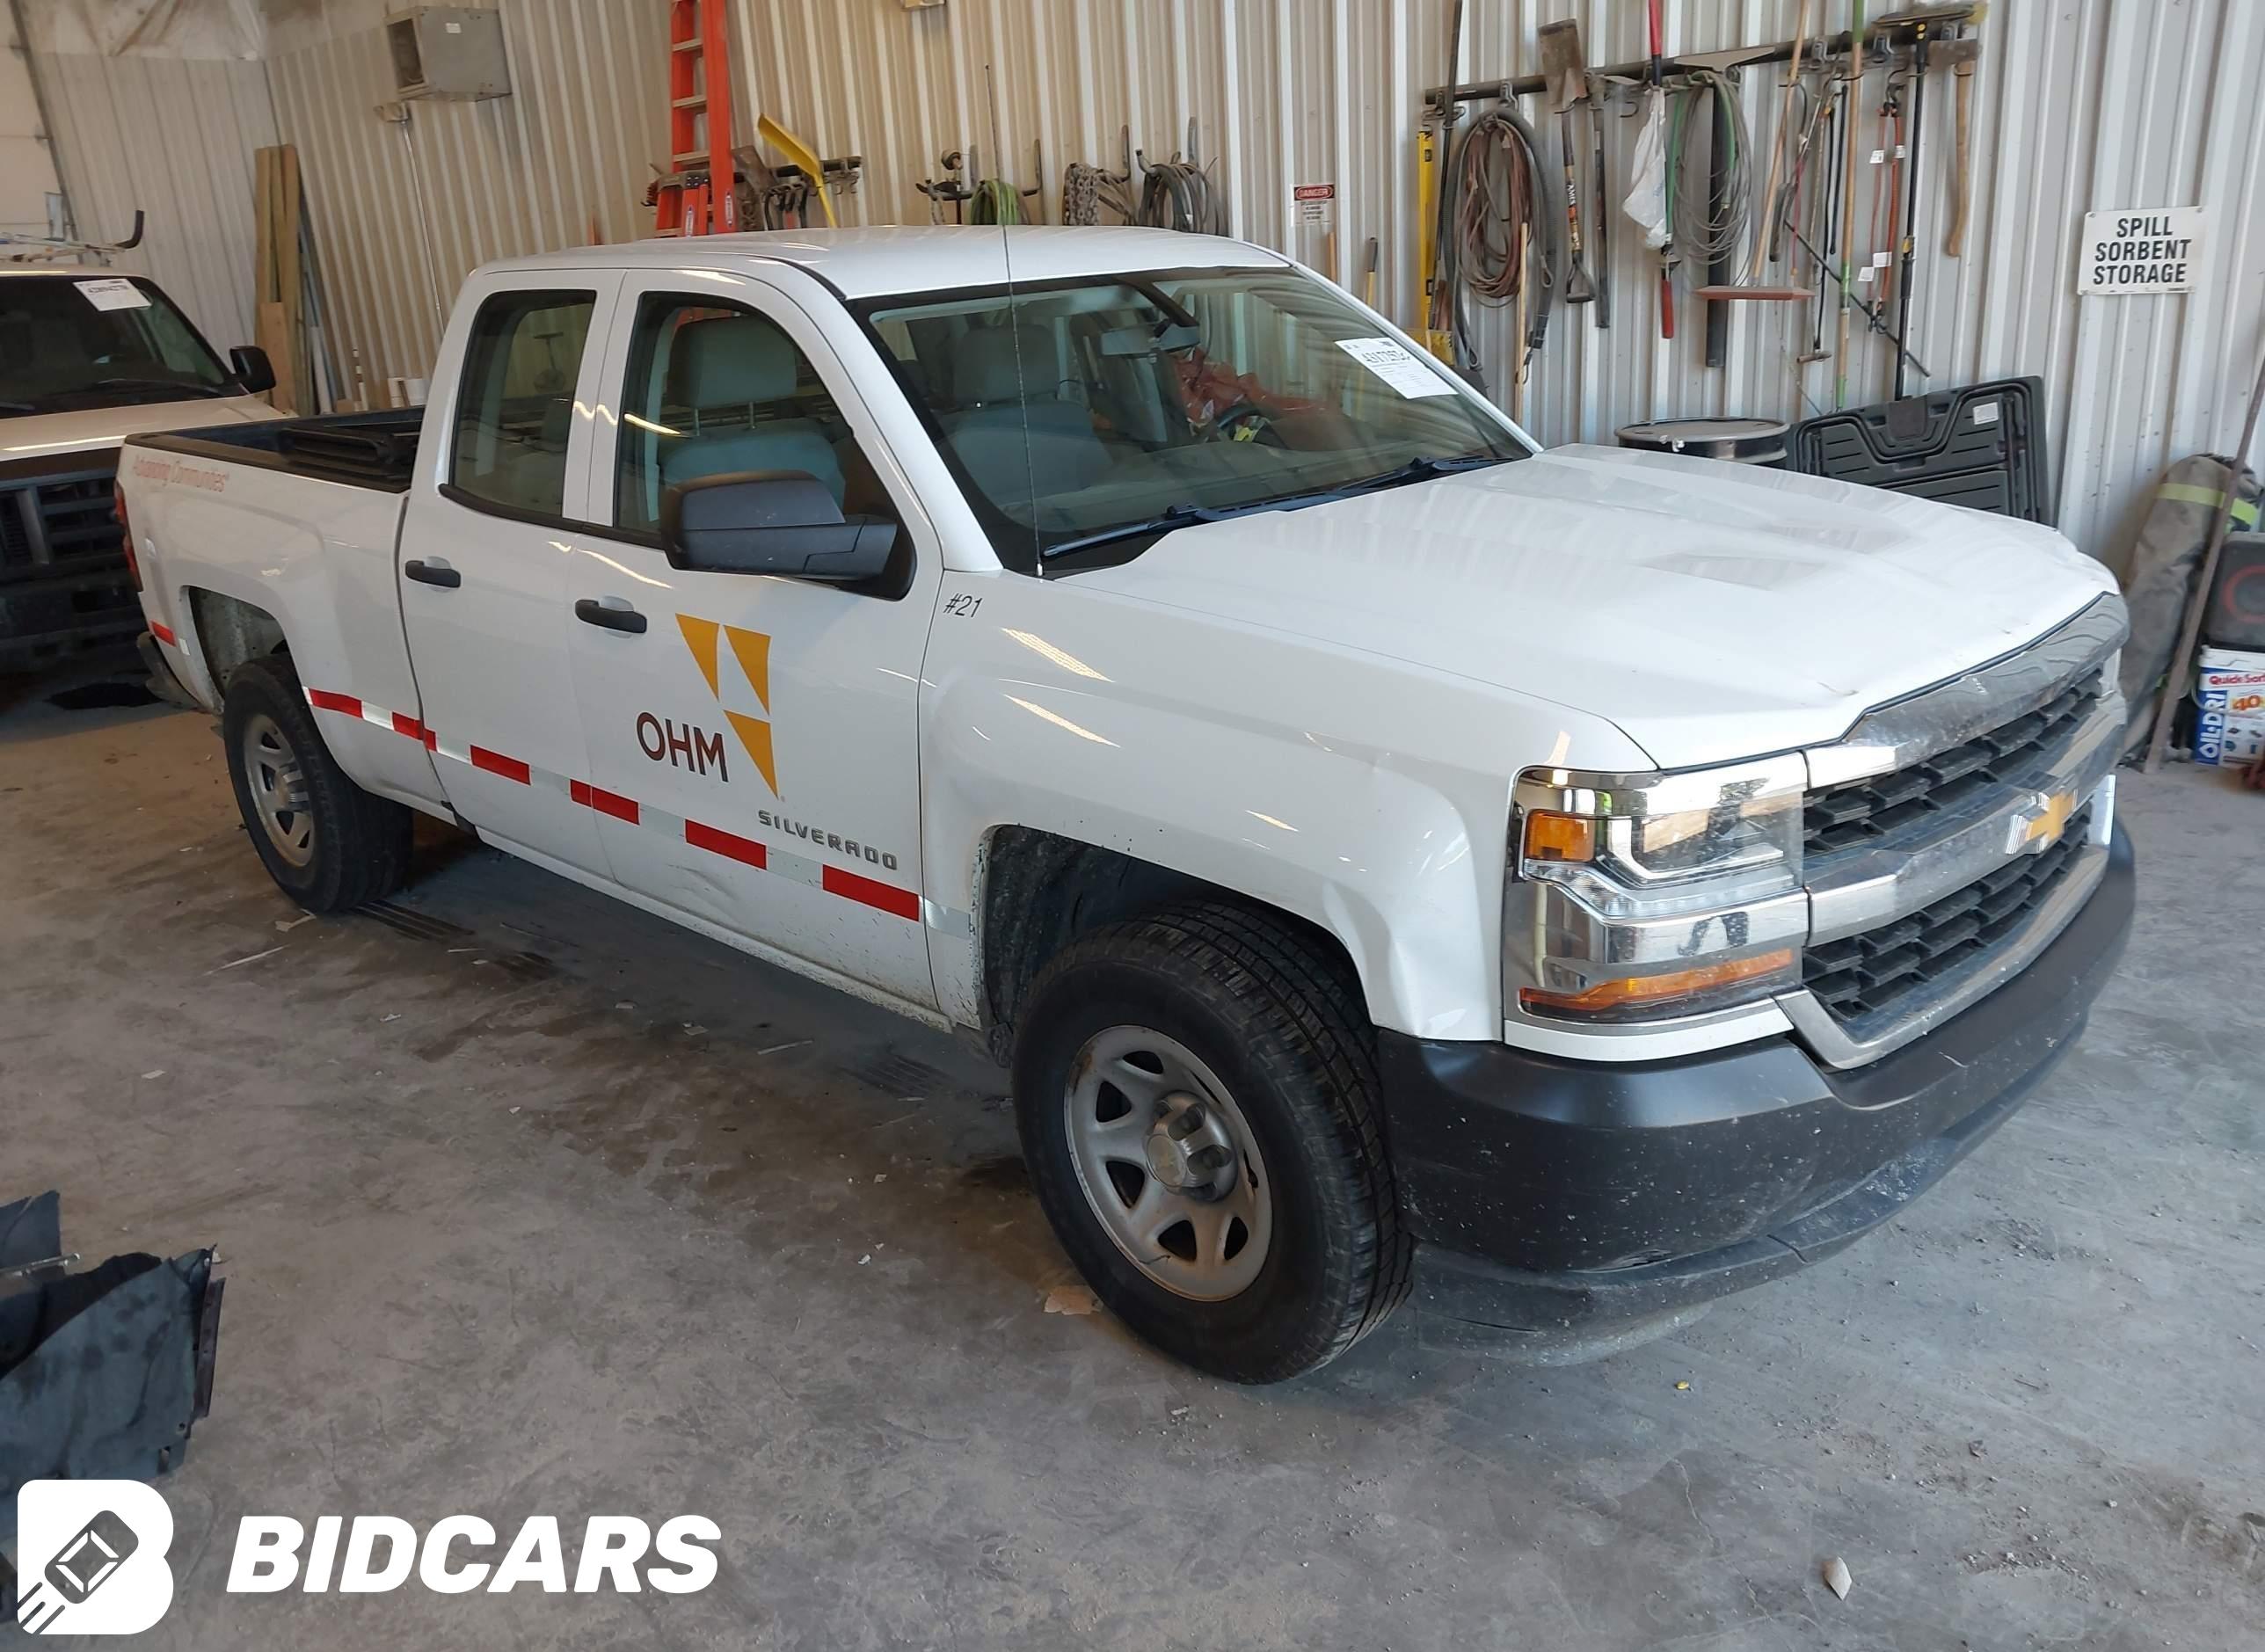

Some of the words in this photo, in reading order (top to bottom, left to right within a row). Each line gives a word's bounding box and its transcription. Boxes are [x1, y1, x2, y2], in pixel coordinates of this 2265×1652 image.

[1299, 187, 1329, 198] DANGER
[2116, 216, 2174, 238] SPILL
[2094, 239, 2192, 262] SORBENT
[2093, 263, 2188, 285] STORAGE
[943, 593, 983, 617] #21
[2232, 695, 2261, 710] 40
[636, 711, 729, 782] OHM
[758, 809, 898, 870] SILVERADO
